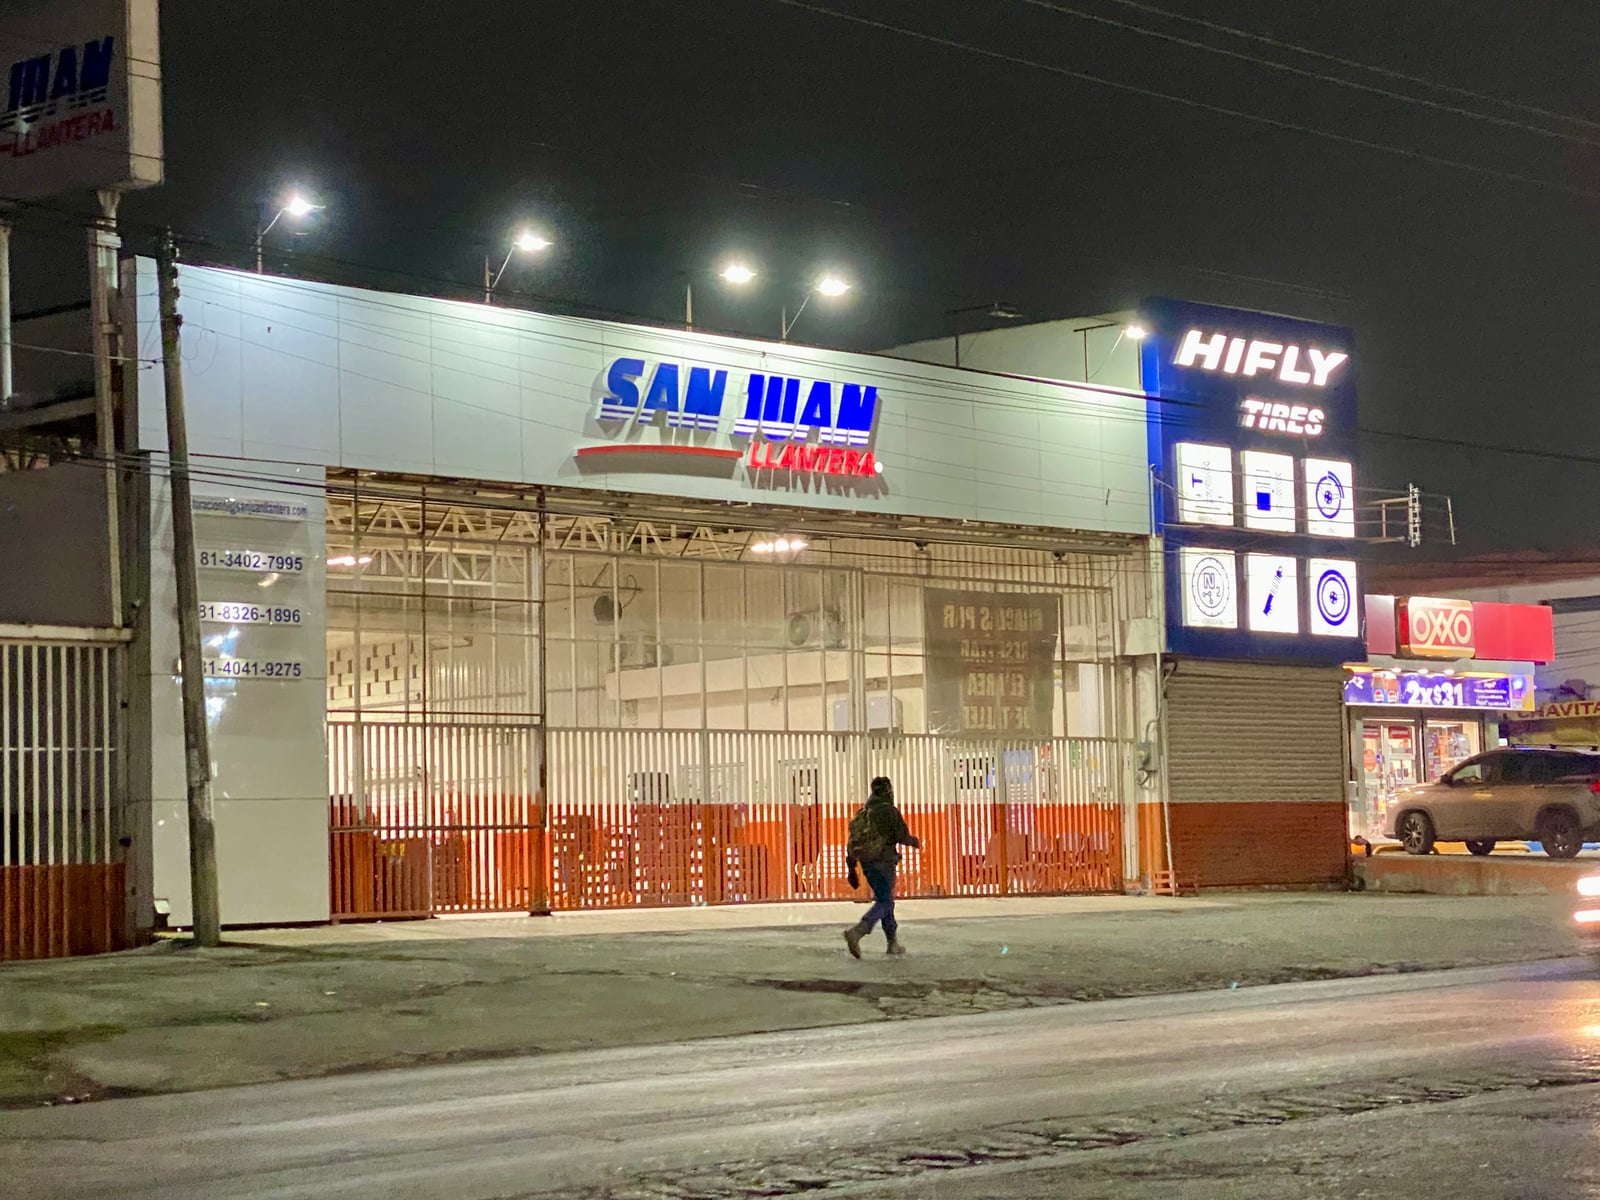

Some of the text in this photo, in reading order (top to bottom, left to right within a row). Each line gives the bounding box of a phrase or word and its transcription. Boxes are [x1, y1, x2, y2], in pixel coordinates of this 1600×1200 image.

[1175, 330, 1348, 386] HIFLY
[600, 357, 877, 446] SAN JUAN
[1242, 400, 1325, 435] TIRES
[750, 441, 875, 477] LLANTERA
[200, 552, 302, 570] 81-3402-7995
[1413, 609, 1471, 645] OXXO
[203, 660, 301, 677] 1-4041-9275
